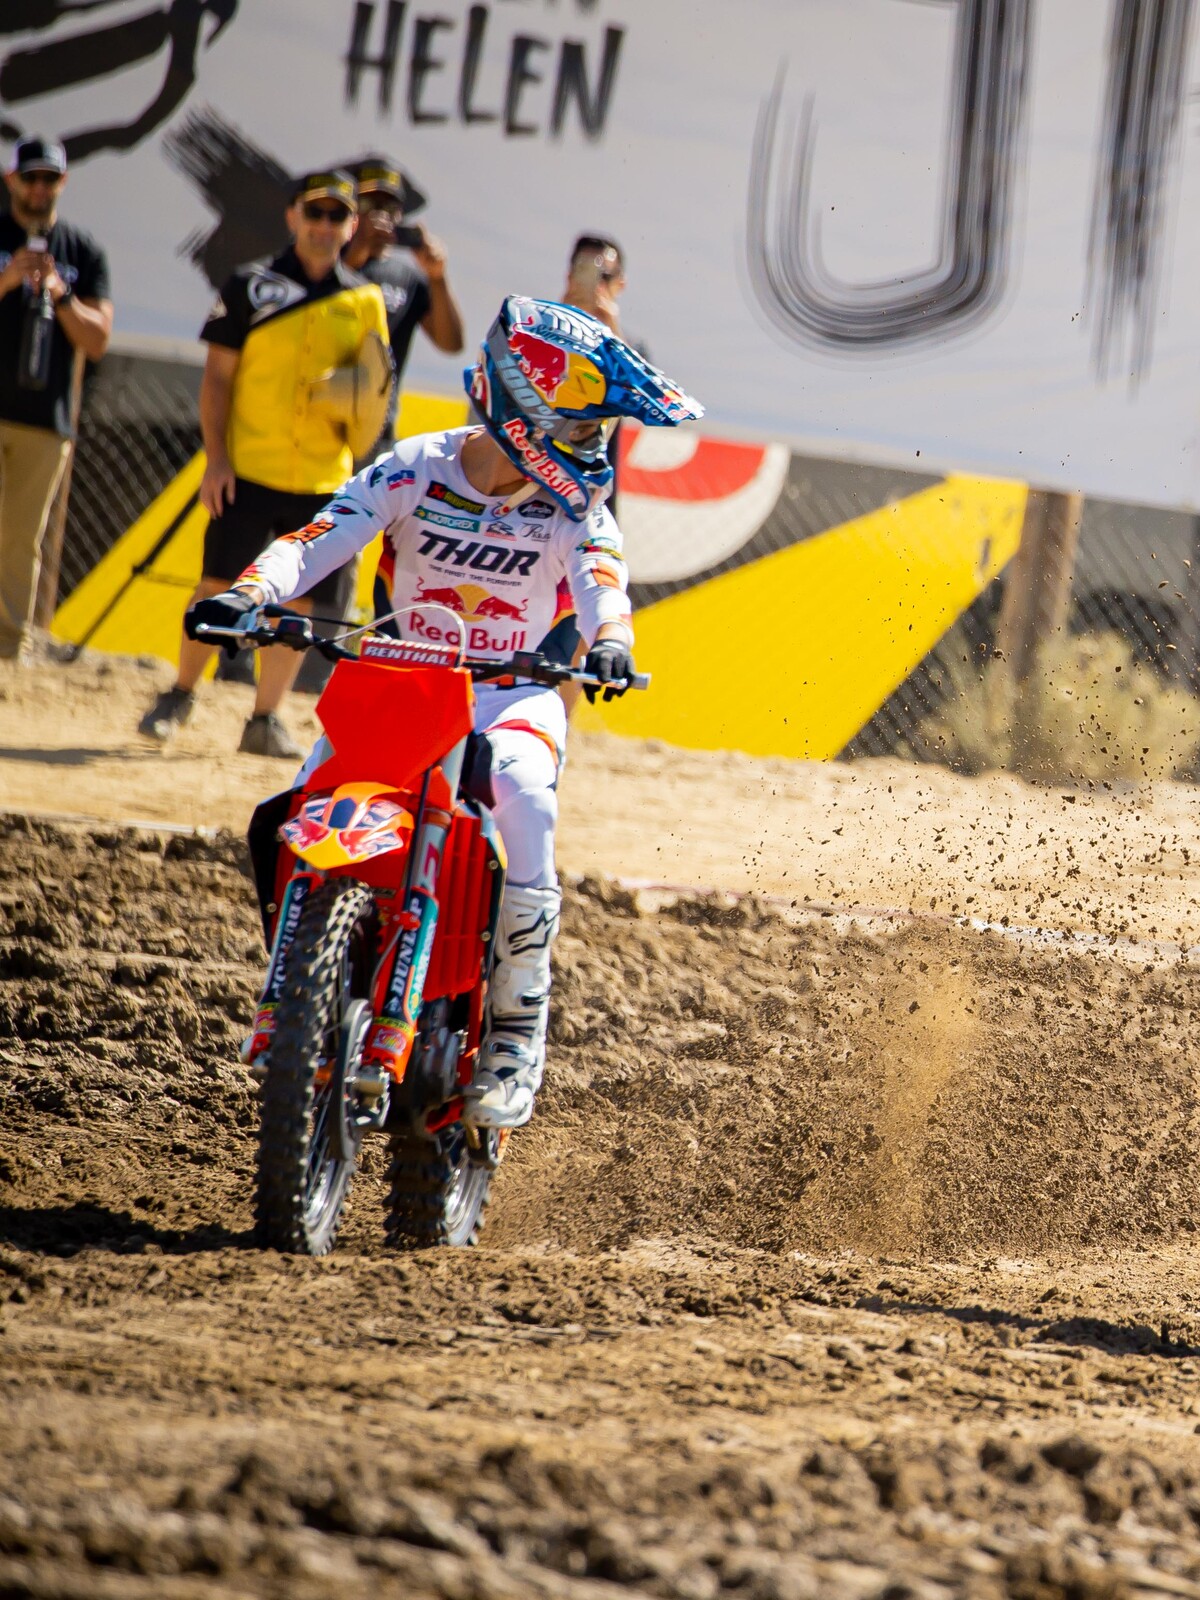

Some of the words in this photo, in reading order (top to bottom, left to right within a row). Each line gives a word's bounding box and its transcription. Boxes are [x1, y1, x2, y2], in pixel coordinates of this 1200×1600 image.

[344, 0, 624, 138] HELEN
[503, 418, 543, 467] Red
[537, 456, 580, 498] Bull
[417, 530, 540, 576] THOR
[364, 645, 449, 665] RENTHAL
[469, 628, 527, 652] Bull
[391, 898, 422, 996] DUNLP
